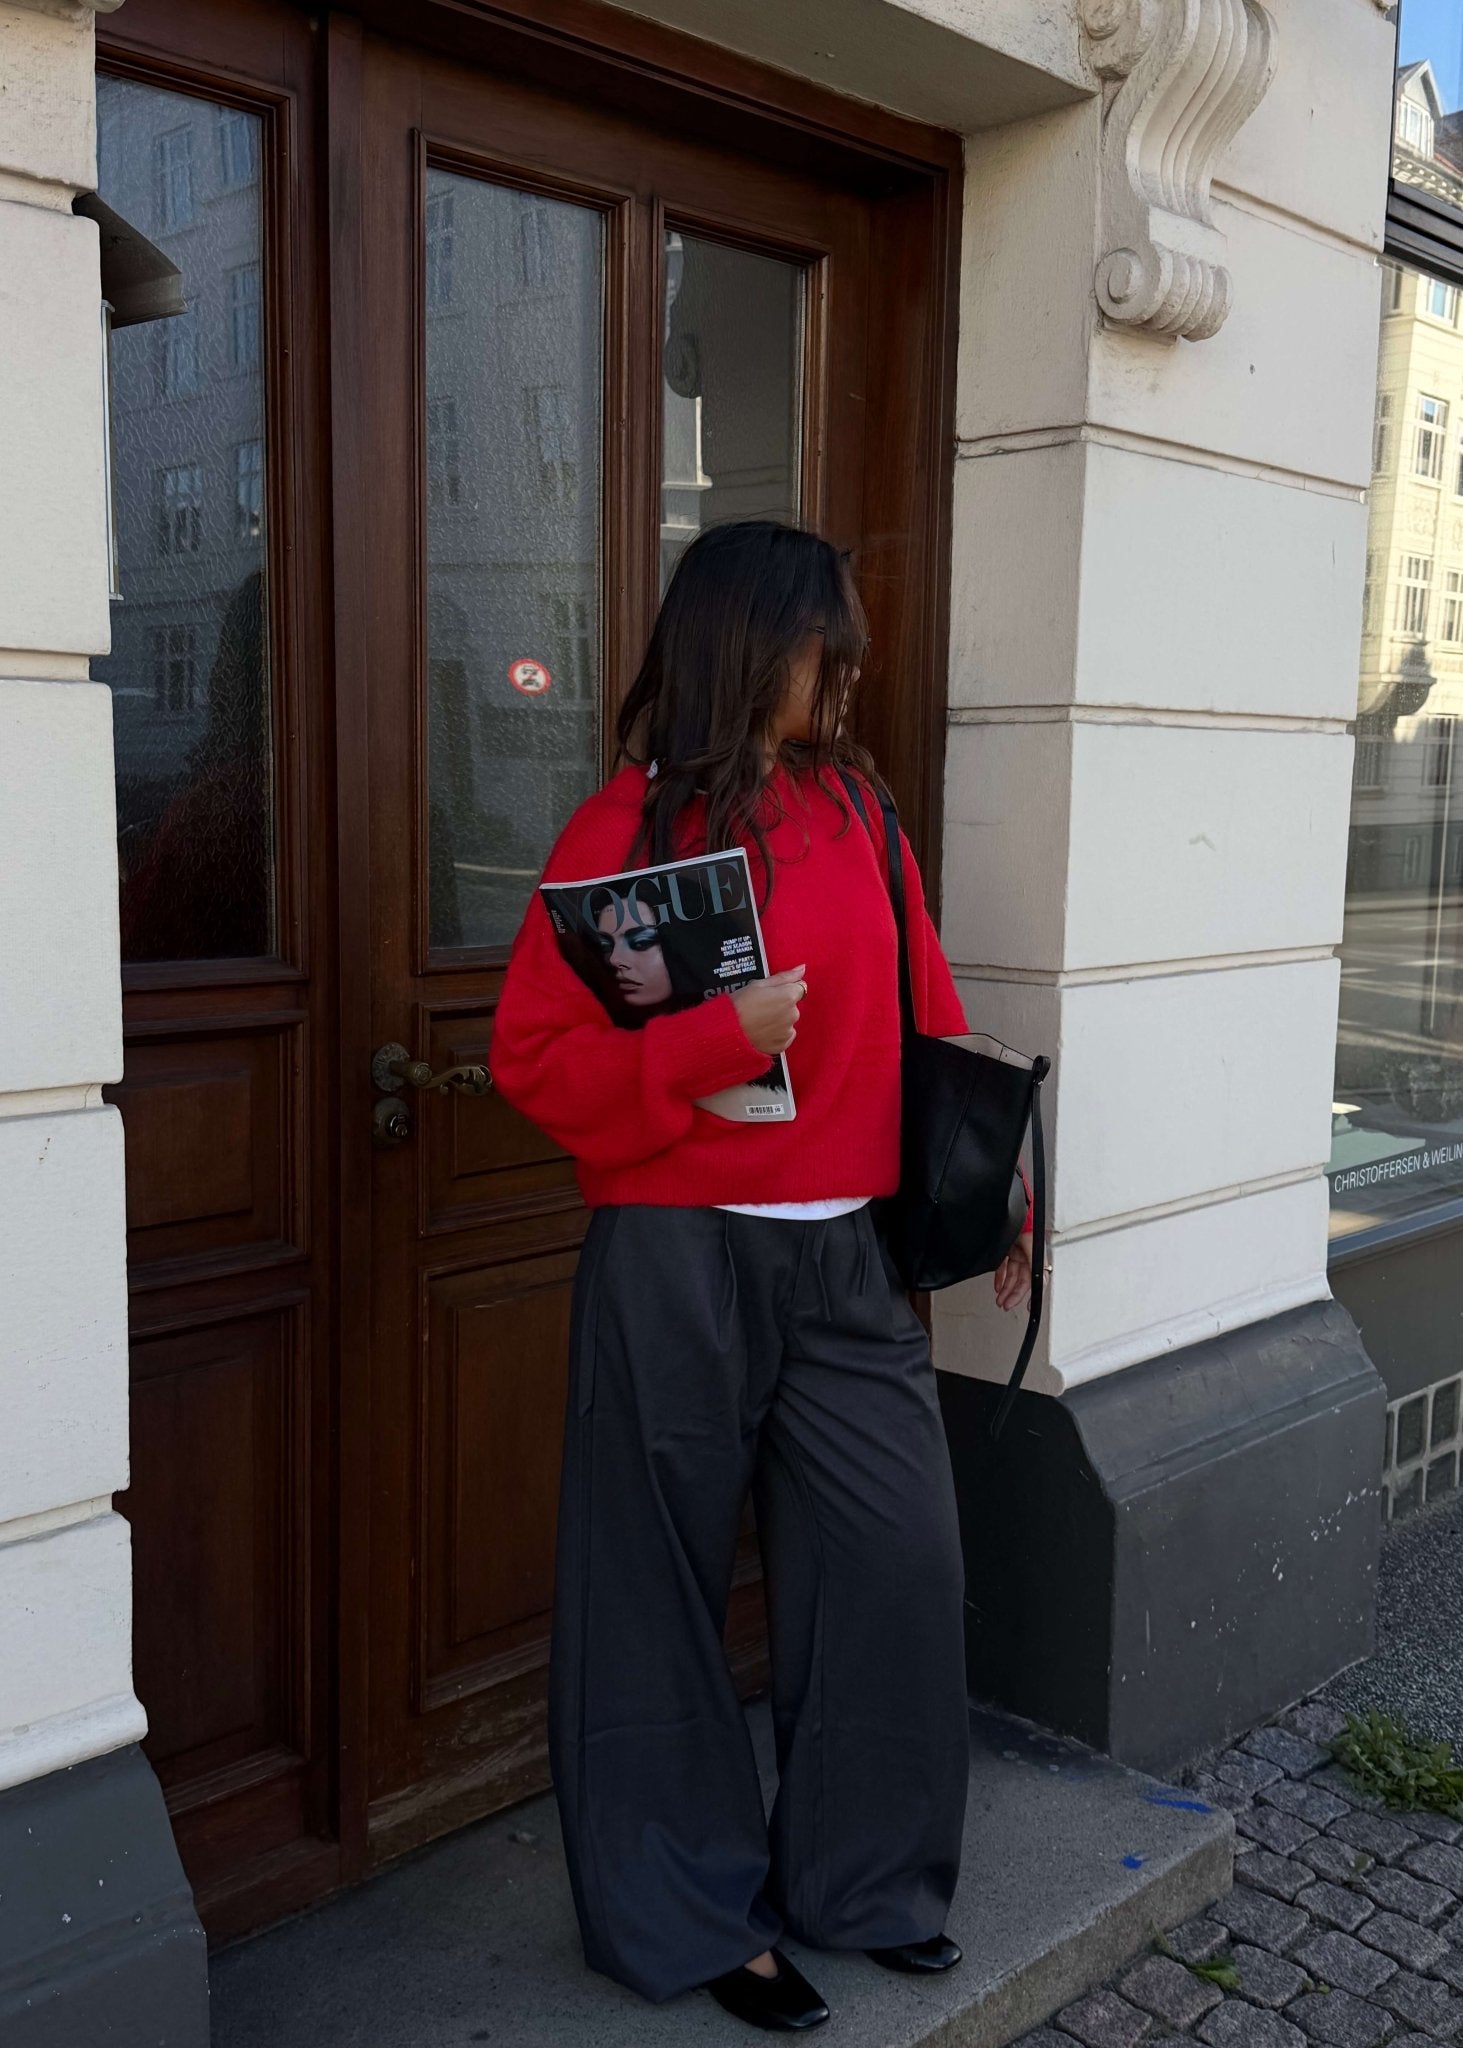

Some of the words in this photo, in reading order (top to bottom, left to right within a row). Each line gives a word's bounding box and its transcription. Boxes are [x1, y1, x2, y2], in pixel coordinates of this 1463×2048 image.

[548, 861, 747, 935] VOGUE
[732, 939, 752, 949] SEASON
[719, 969, 742, 978] WEDDING
[1334, 1153, 1421, 1193] CHRISTOFFERSEN
[1422, 1151, 1430, 1169] &
